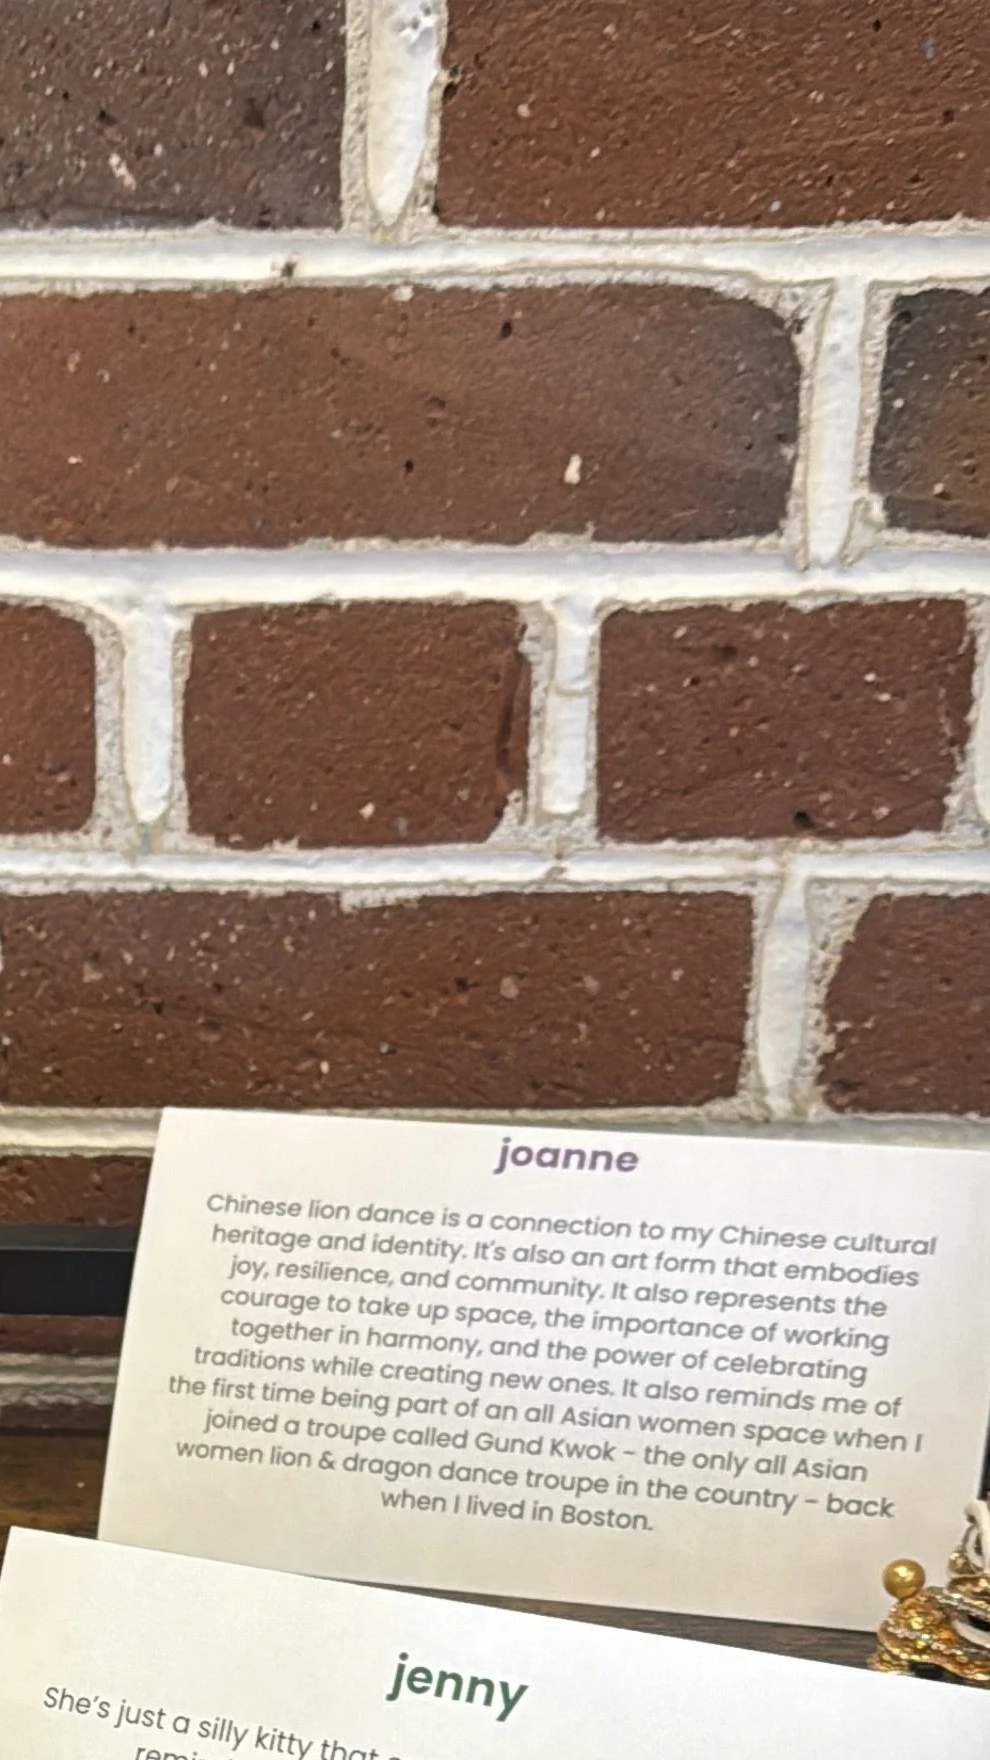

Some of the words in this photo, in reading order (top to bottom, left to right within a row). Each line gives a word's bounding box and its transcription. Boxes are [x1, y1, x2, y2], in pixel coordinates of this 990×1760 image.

[492, 1136, 640, 1176] joanne
[206, 1193, 303, 1218] Chinese
[307, 1199, 351, 1221] lion
[356, 1202, 436, 1227] dance
[440, 1206, 461, 1228] is
[465, 1213, 485, 1229] a
[489, 1214, 632, 1239] connection
[639, 1220, 666, 1241] to
[670, 1225, 715, 1249] my
[718, 1224, 828, 1250] Chinese
[833, 1233, 938, 1256] cultural
[211, 1223, 313, 1254] heritage
[316, 1232, 367, 1253] and
[370, 1232, 468, 1265] identity.
[511, 1243, 566, 1265] also
[570, 1250, 606, 1268] an
[610, 1251, 650, 1271] art
[654, 1250, 717, 1275] form
[723, 1255, 779, 1279] that
[783, 1261, 921, 1287] embodies
[227, 1253, 270, 1283] joy,
[274, 1259, 395, 1289] resilience,
[399, 1268, 451, 1289] and
[454, 1274, 606, 1305] community.
[610, 1281, 630, 1301] It
[633, 1282, 690, 1305] also
[693, 1289, 837, 1315] represents
[843, 1294, 889, 1318] the
[220, 1289, 322, 1317] courage
[326, 1293, 353, 1314] to
[357, 1295, 411, 1318] take
[416, 1303, 450, 1327] up
[454, 1305, 538, 1330] space,
[544, 1307, 586, 1330] the
[590, 1309, 745, 1341] importance
[750, 1321, 780, 1343] of
[783, 1326, 891, 1358] working
[231, 1317, 335, 1345] together
[338, 1323, 361, 1345] in
[365, 1325, 484, 1361] harmony,
[489, 1337, 541, 1359] and
[546, 1339, 588, 1362] the
[592, 1346, 677, 1369] power
[680, 1348, 710, 1371] of
[712, 1352, 869, 1389] celebrating
[168, 1375, 207, 1397] the
[212, 1376, 257, 1401] first
[261, 1381, 316, 1405] time
[320, 1385, 391, 1418] being
[394, 1396, 450, 1419] part
[453, 1396, 481, 1419] of
[484, 1403, 519, 1422] an
[523, 1403, 556, 1424] all
[559, 1405, 632, 1431] Asian
[637, 1414, 737, 1439] women
[742, 1423, 828, 1448] space
[833, 1427, 908, 1452] when
[914, 1433, 923, 1453] I
[194, 1346, 306, 1373] traditions
[311, 1355, 375, 1379] while
[379, 1363, 484, 1393] creating
[489, 1371, 544, 1391] new
[547, 1375, 616, 1397] ones.
[621, 1377, 640, 1399] It
[643, 1379, 700, 1403] also
[705, 1385, 817, 1412] reminds
[821, 1396, 869, 1416] me
[873, 1396, 903, 1418] of
[202, 1407, 280, 1435] joined
[283, 1418, 302, 1436] a
[306, 1417, 388, 1447] troupe
[391, 1425, 470, 1450] called
[473, 1431, 545, 1456] Gund
[549, 1436, 617, 1463] Kwok
[643, 1444, 687, 1468] the
[691, 1449, 750, 1480] only
[753, 1454, 788, 1477] all
[791, 1457, 869, 1483] Asian
[176, 1441, 264, 1464] women
[269, 1444, 313, 1469] lion
[317, 1449, 337, 1471] &
[341, 1451, 433, 1483] dragon
[437, 1459, 519, 1487] dance
[525, 1468, 611, 1499] troupe
[615, 1473, 640, 1497] in
[645, 1477, 689, 1501] the
[693, 1485, 799, 1517] country
[825, 1491, 896, 1519] back
[380, 1487, 448, 1513] when
[453, 1493, 461, 1514] I
[465, 1493, 527, 1520] lived
[531, 1499, 554, 1523] in
[560, 1503, 654, 1532] Boston.
[384, 1651, 530, 1723] jenny
[113, 1698, 167, 1730] just
[172, 1715, 191, 1735] a
[197, 1716, 250, 1752] silly
